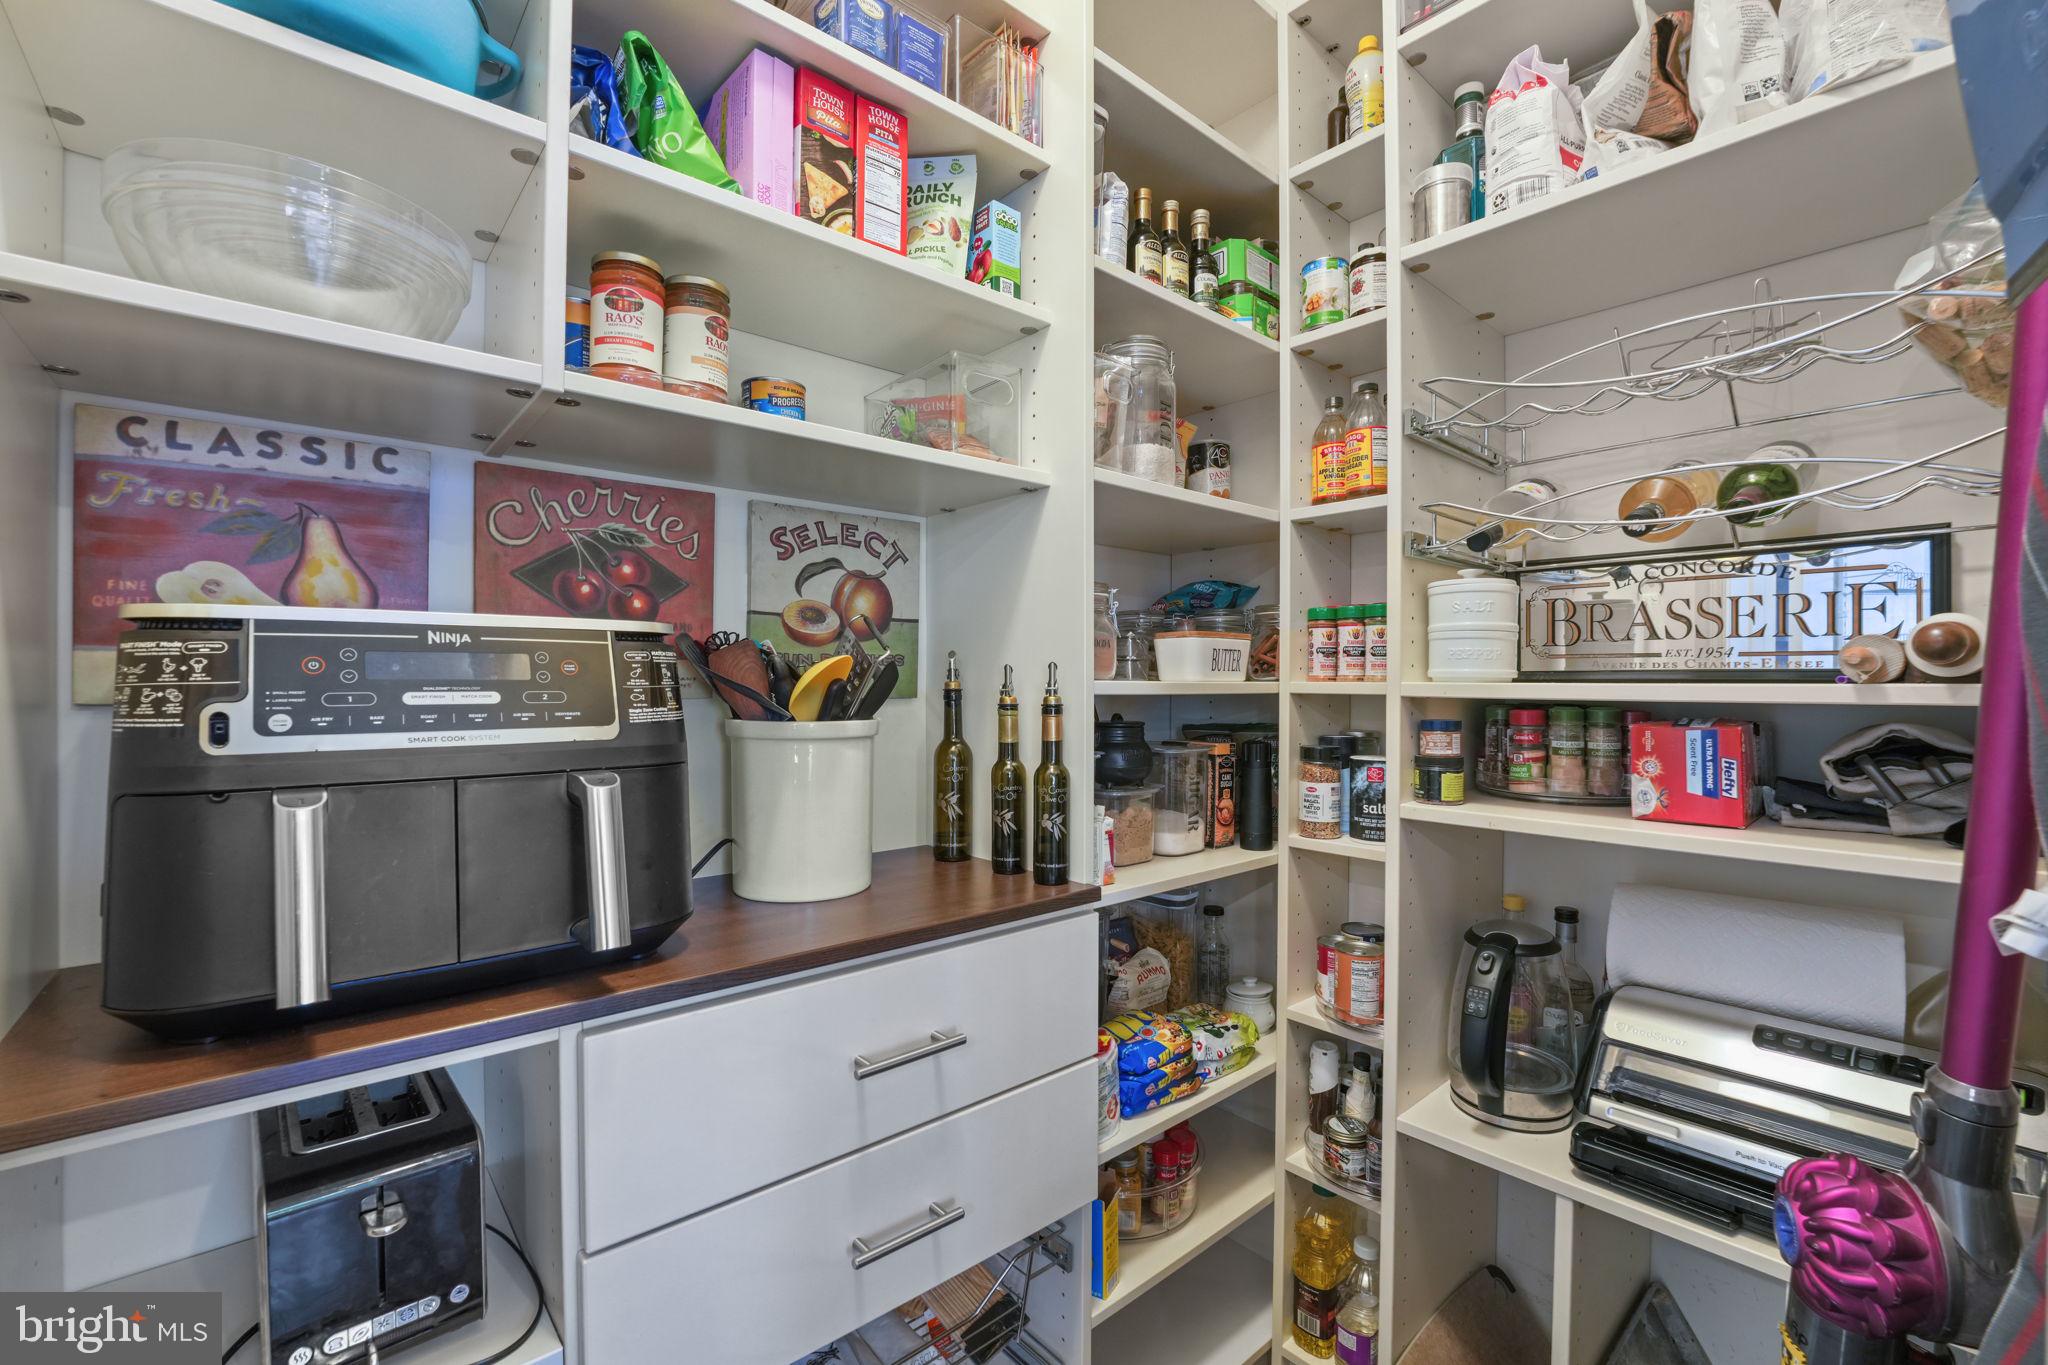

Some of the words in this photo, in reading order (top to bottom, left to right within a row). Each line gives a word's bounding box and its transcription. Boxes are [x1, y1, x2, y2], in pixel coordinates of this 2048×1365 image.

[813, 88, 844, 109] TOWN
[813, 97, 845, 120] HOUSE
[869, 106, 899, 126] TOWN
[816, 110, 841, 128] Pita
[868, 115, 900, 135] HOUSE
[875, 128, 894, 141] PITA
[907, 193, 962, 207] RUNCH
[914, 245, 946, 255] PICKLE
[605, 312, 643, 326] RAO'S
[116, 415, 399, 475] CLASSIC
[1352, 454, 1369, 463] CIDER
[1319, 467, 1335, 475] APPLE
[87, 470, 232, 513] Fresh
[486, 485, 701, 561] Cherries
[769, 520, 910, 570] SELECT
[1614, 570, 1638, 590] LA
[1644, 559, 1797, 581] CONCORDE
[106, 578, 149, 591] FINE
[1451, 600, 1495, 614] SALT
[1543, 581, 1905, 648] BRASSERIE
[427, 630, 472, 647] NINJA
[1211, 647, 1242, 673] BUTTER
[1591, 659, 1647, 669] AVENUE
[1652, 661, 1678, 669] DES
[440, 735, 466, 743] COOK
[468, 734, 500, 742] SYSTEM
[1706, 760, 1714, 789] STRONG
[1722, 760, 1736, 796] Hefty
[998, 783, 1022, 794] Country
[1136, 966, 1167, 985] RUMMO
[1625, 1025, 1688, 1047] FoodSaver
[1735, 1150, 1757, 1162] Push
